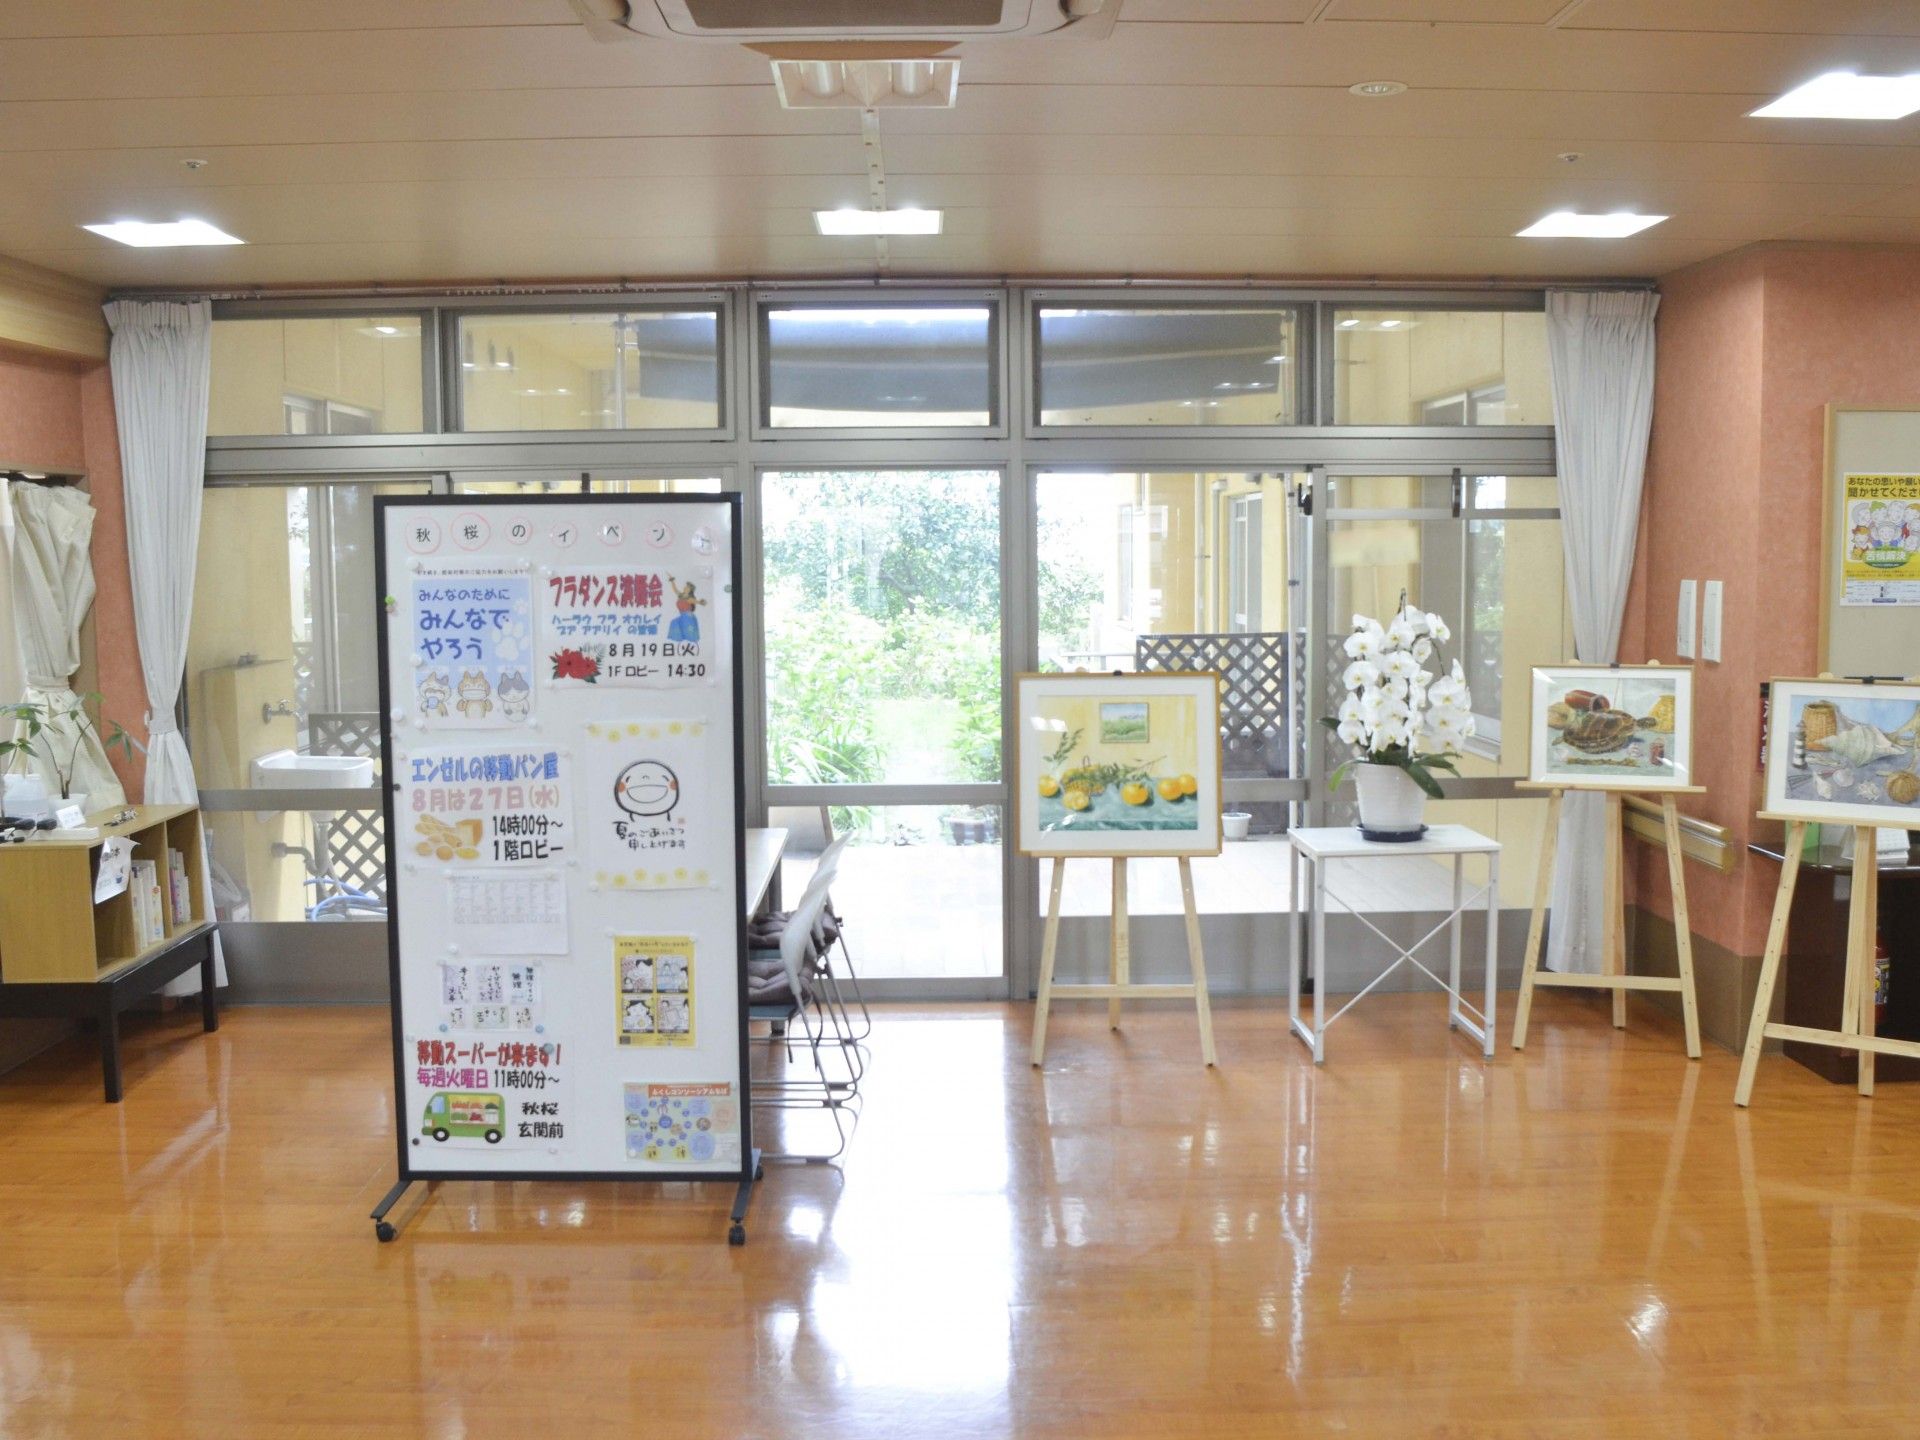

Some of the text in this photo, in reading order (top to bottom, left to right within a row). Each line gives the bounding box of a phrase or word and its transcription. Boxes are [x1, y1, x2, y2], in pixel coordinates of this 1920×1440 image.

[1848, 487, 1920, 498] 聞かせてくださ
[419, 588, 511, 601] みんなのために
[420, 608, 510, 630] みんなで
[420, 637, 483, 660] やろう
[668, 663, 706, 677] 14:30
[493, 839, 564, 861] 1階ロビー
[417, 1067, 489, 1089] 毎週火曜日
[521, 1101, 560, 1116] 秋桜
[518, 1121, 564, 1139] 玄関前
